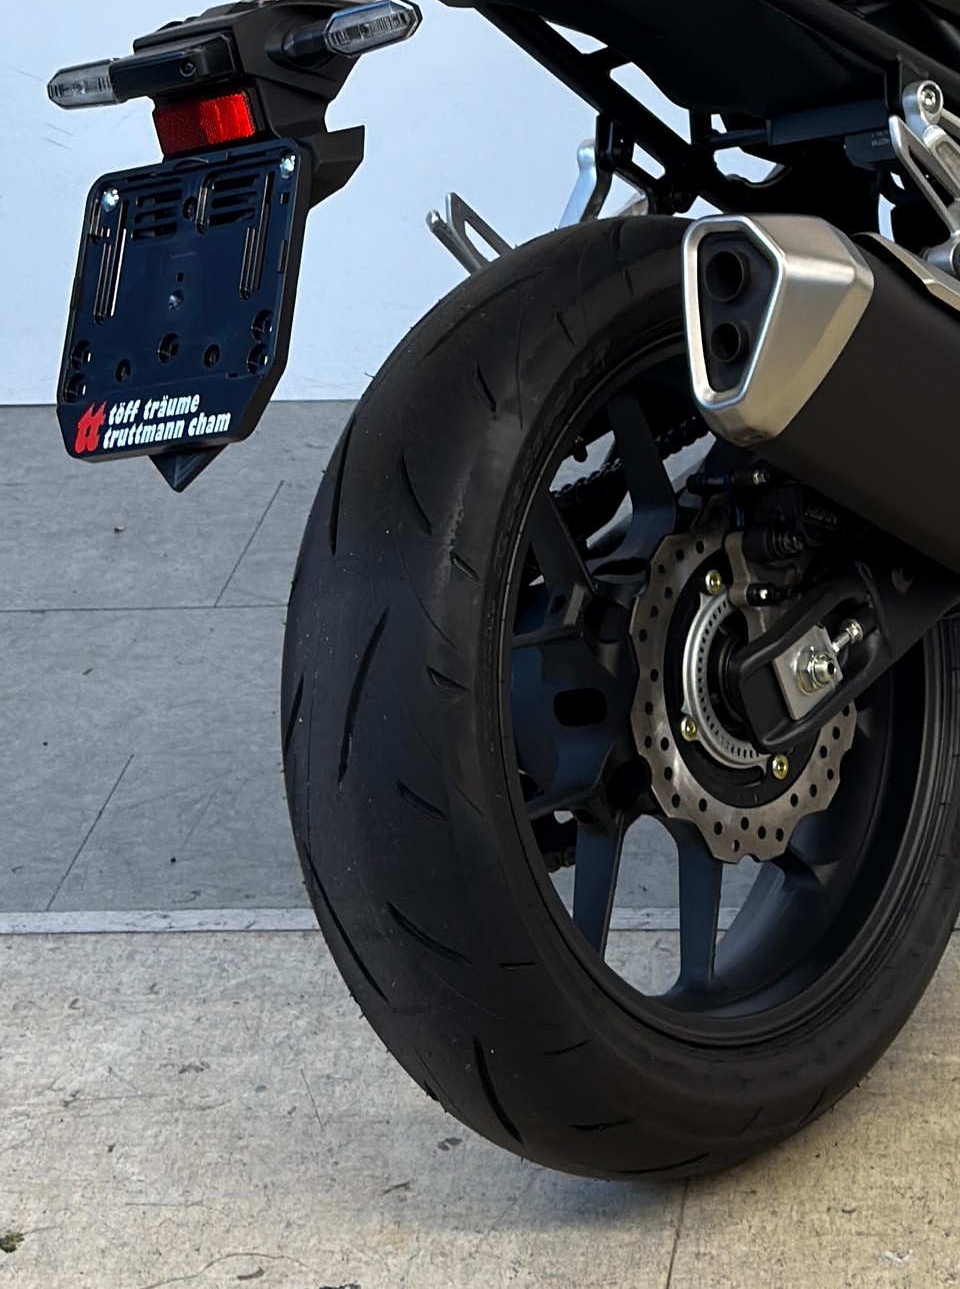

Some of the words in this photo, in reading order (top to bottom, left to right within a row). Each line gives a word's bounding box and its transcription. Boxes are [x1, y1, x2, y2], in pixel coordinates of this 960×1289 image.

[108, 399, 141, 425] töff
[142, 393, 200, 420] träume
[103, 419, 185, 449] truttmann
[187, 412, 231, 436] cham
